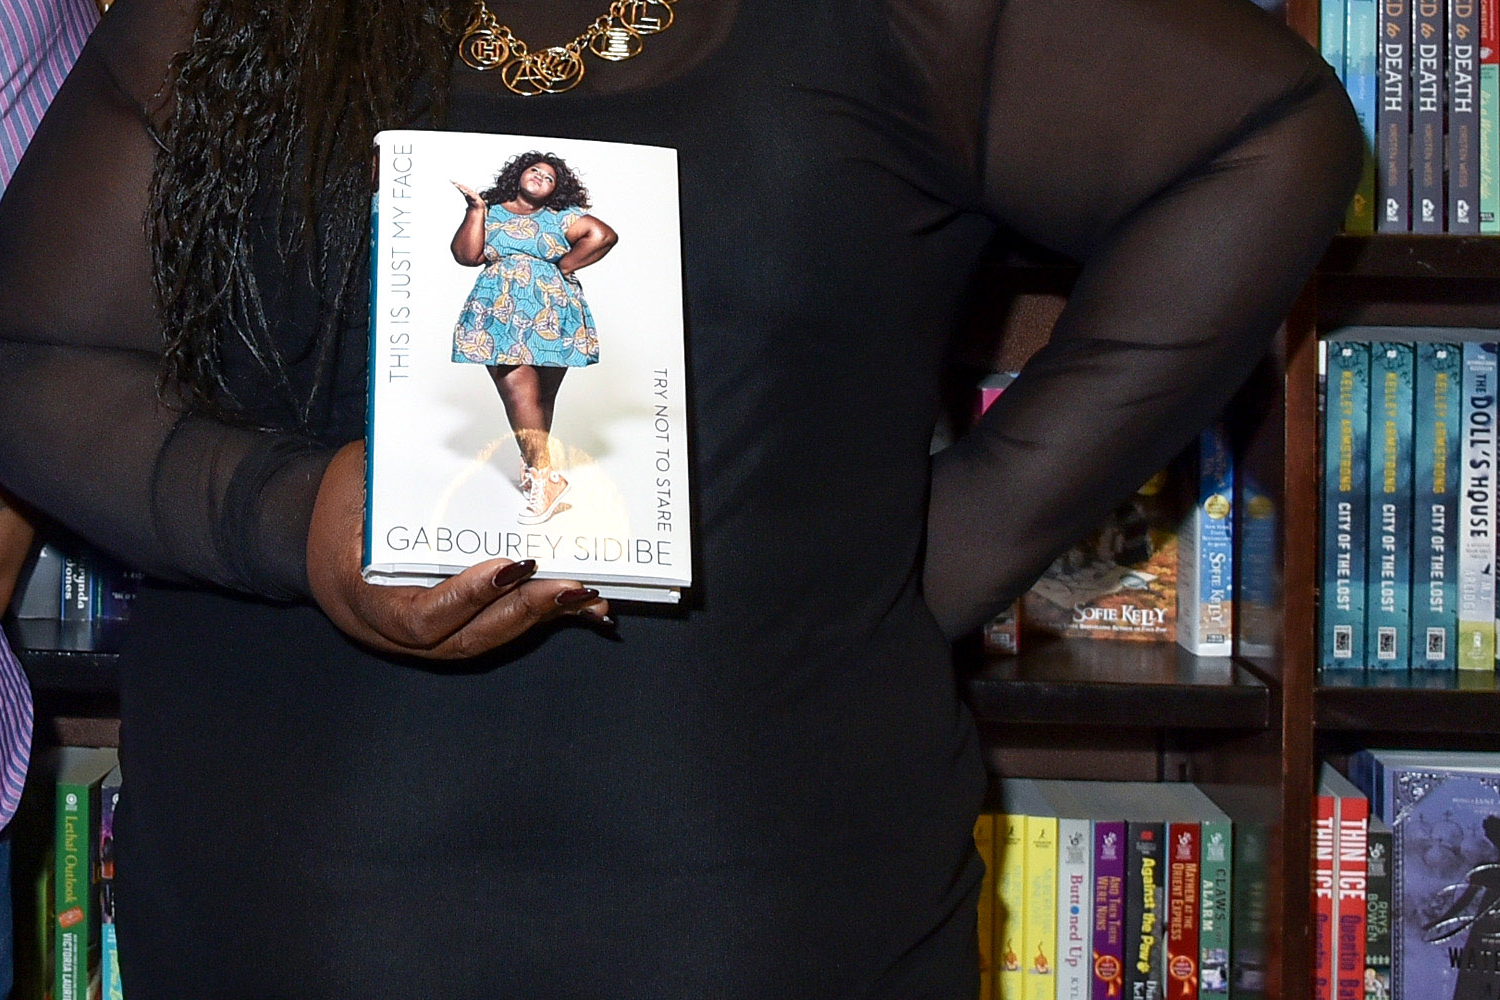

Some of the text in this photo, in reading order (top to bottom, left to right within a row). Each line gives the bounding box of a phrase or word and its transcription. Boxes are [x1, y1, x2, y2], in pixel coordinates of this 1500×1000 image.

[1386, 22, 1401, 38] to
[1420, 22, 1436, 40] to
[1456, 24, 1472, 40] to
[1384, 43, 1403, 112] DEATH
[1419, 44, 1438, 112] DEATH
[1454, 44, 1473, 112] DEATH
[388, 144, 413, 383] THIS IS JUST MY FACE
[654, 368, 672, 532] TRY NOT TO STARE
[1467, 374, 1492, 538] THE DOLL'S HOUSE
[385, 525, 672, 567] GABOUREY SIDIBE
[1430, 504, 1446, 614] CITY OF THE LOST
[1072, 602, 1169, 626] SOFIE KELLY
[64, 816, 78, 903] Lethal Outlook
[1142, 858, 1156, 909] Against
[1316, 817, 1334, 900] THIN ICE
[1339, 818, 1368, 900] THIN ICE
[1142, 912, 1154, 932] the
[1066, 946, 1082, 967] Up
